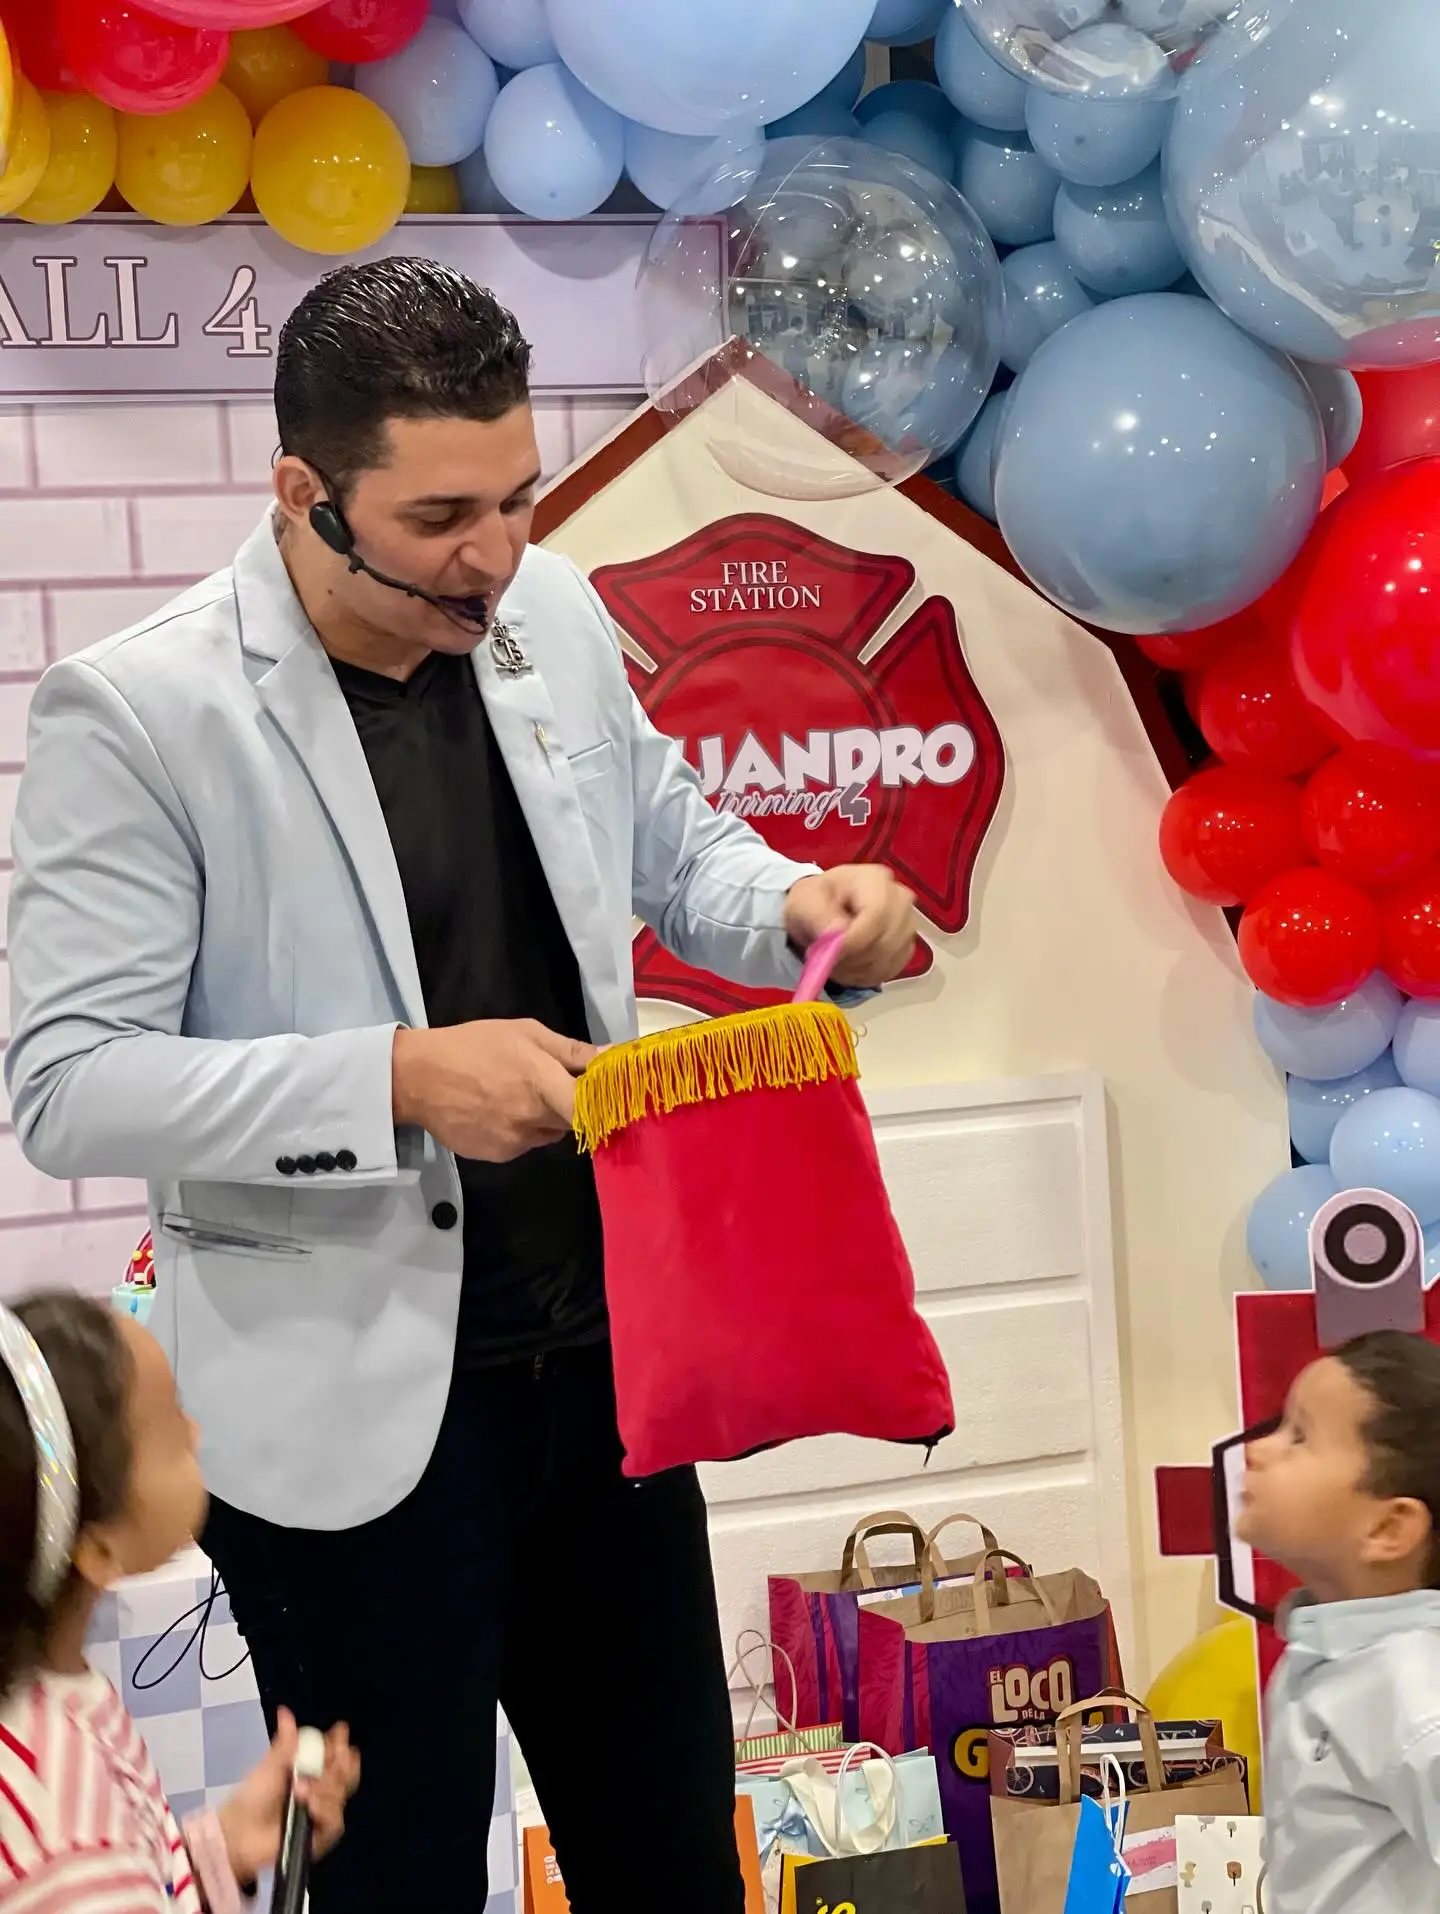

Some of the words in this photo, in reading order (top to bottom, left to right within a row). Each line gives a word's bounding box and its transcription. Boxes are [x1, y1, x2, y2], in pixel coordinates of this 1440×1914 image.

[202, 264, 272, 357] 4
[721, 560, 788, 585] FIRE
[690, 585, 821, 612] STATION
[676, 722, 976, 798] JANDRO
[838, 782, 871, 827] 4
[989, 1670, 1003, 1684] EL
[991, 1660, 1072, 1723] LOCO
